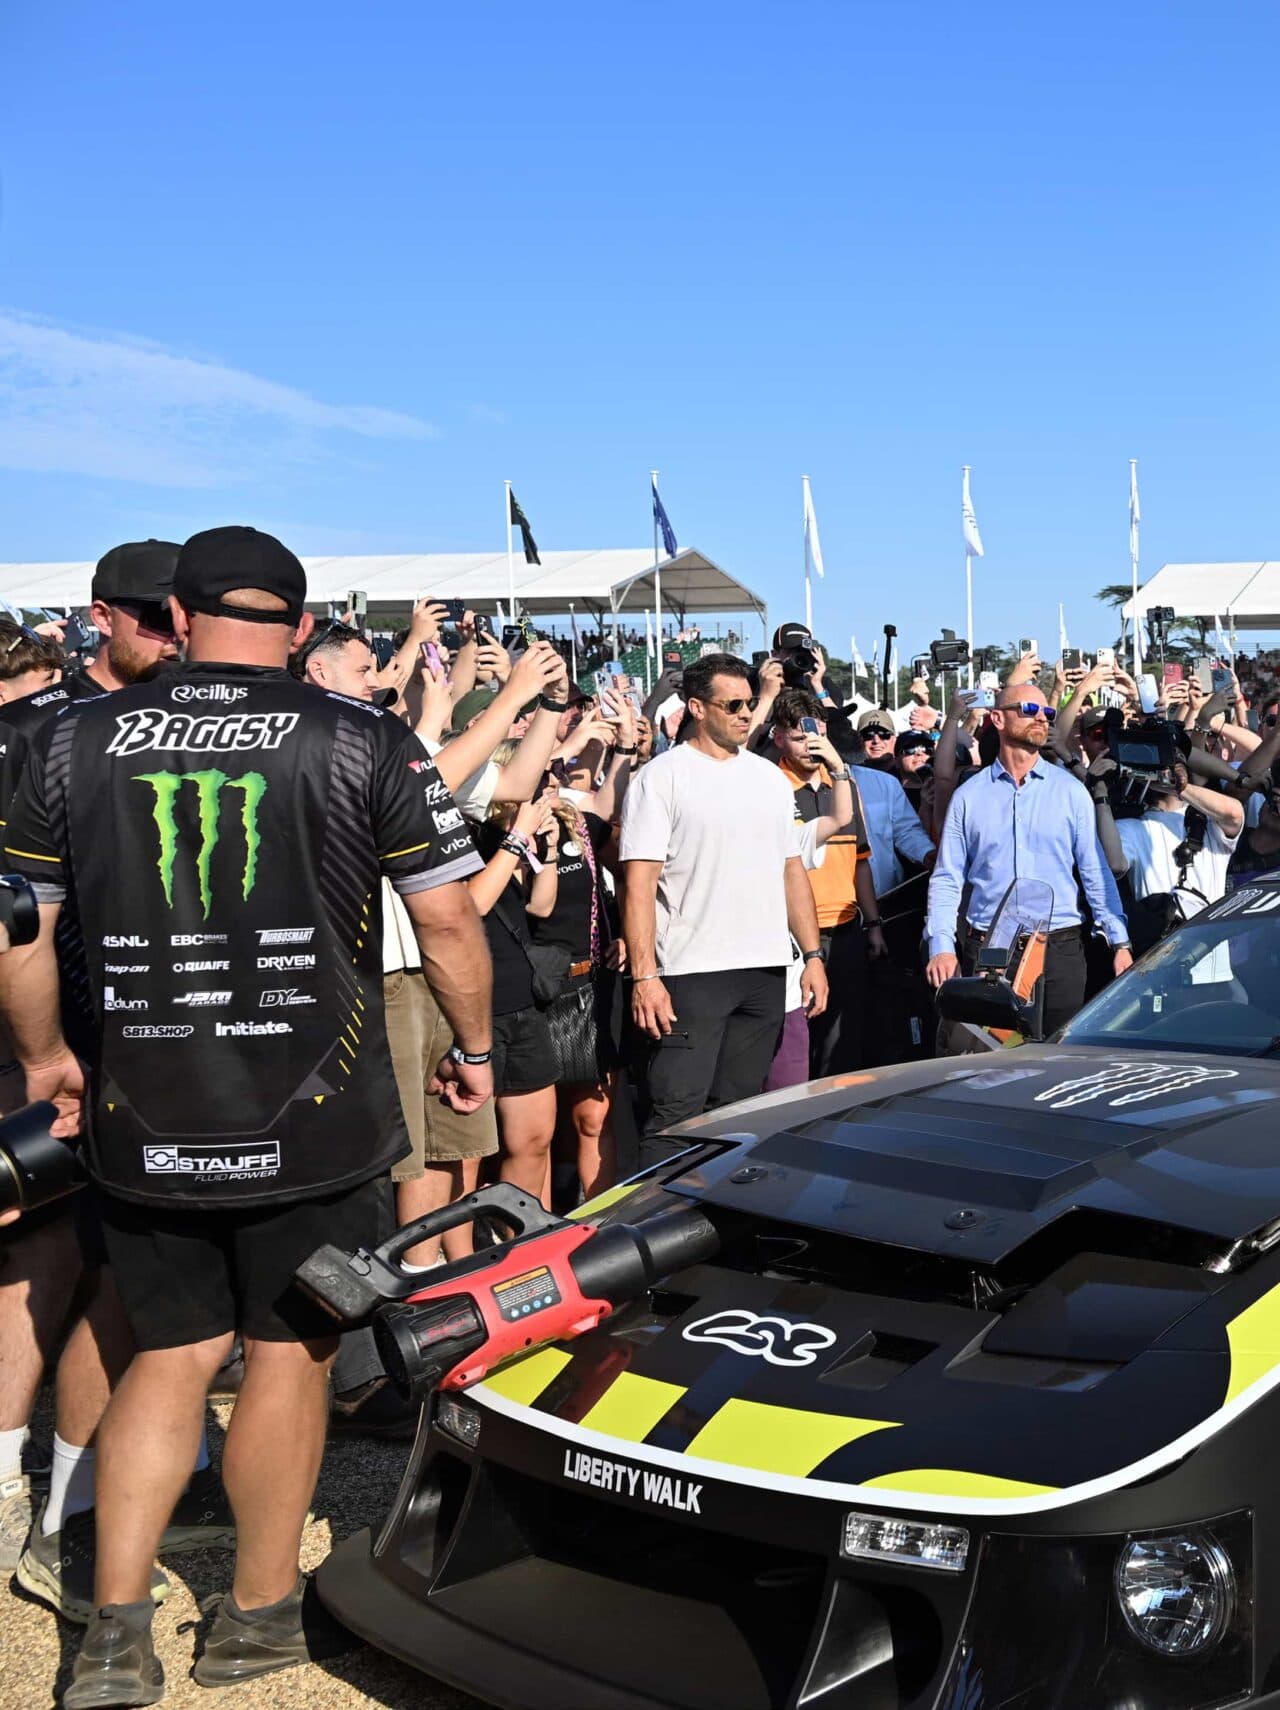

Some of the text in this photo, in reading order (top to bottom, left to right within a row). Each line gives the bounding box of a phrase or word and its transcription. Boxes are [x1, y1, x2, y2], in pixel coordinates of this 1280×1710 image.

[105, 708, 300, 757] BAGGSY
[171, 934, 203, 947] EBC
[104, 963, 150, 975] nap-on
[185, 960, 231, 972] QUAIFE
[257, 954, 316, 971] DRIVEN
[178, 1153, 278, 1171] STAUFF
[194, 1170, 278, 1182] FLUID POWER
[563, 1449, 703, 1514] LIBERTY WALK
